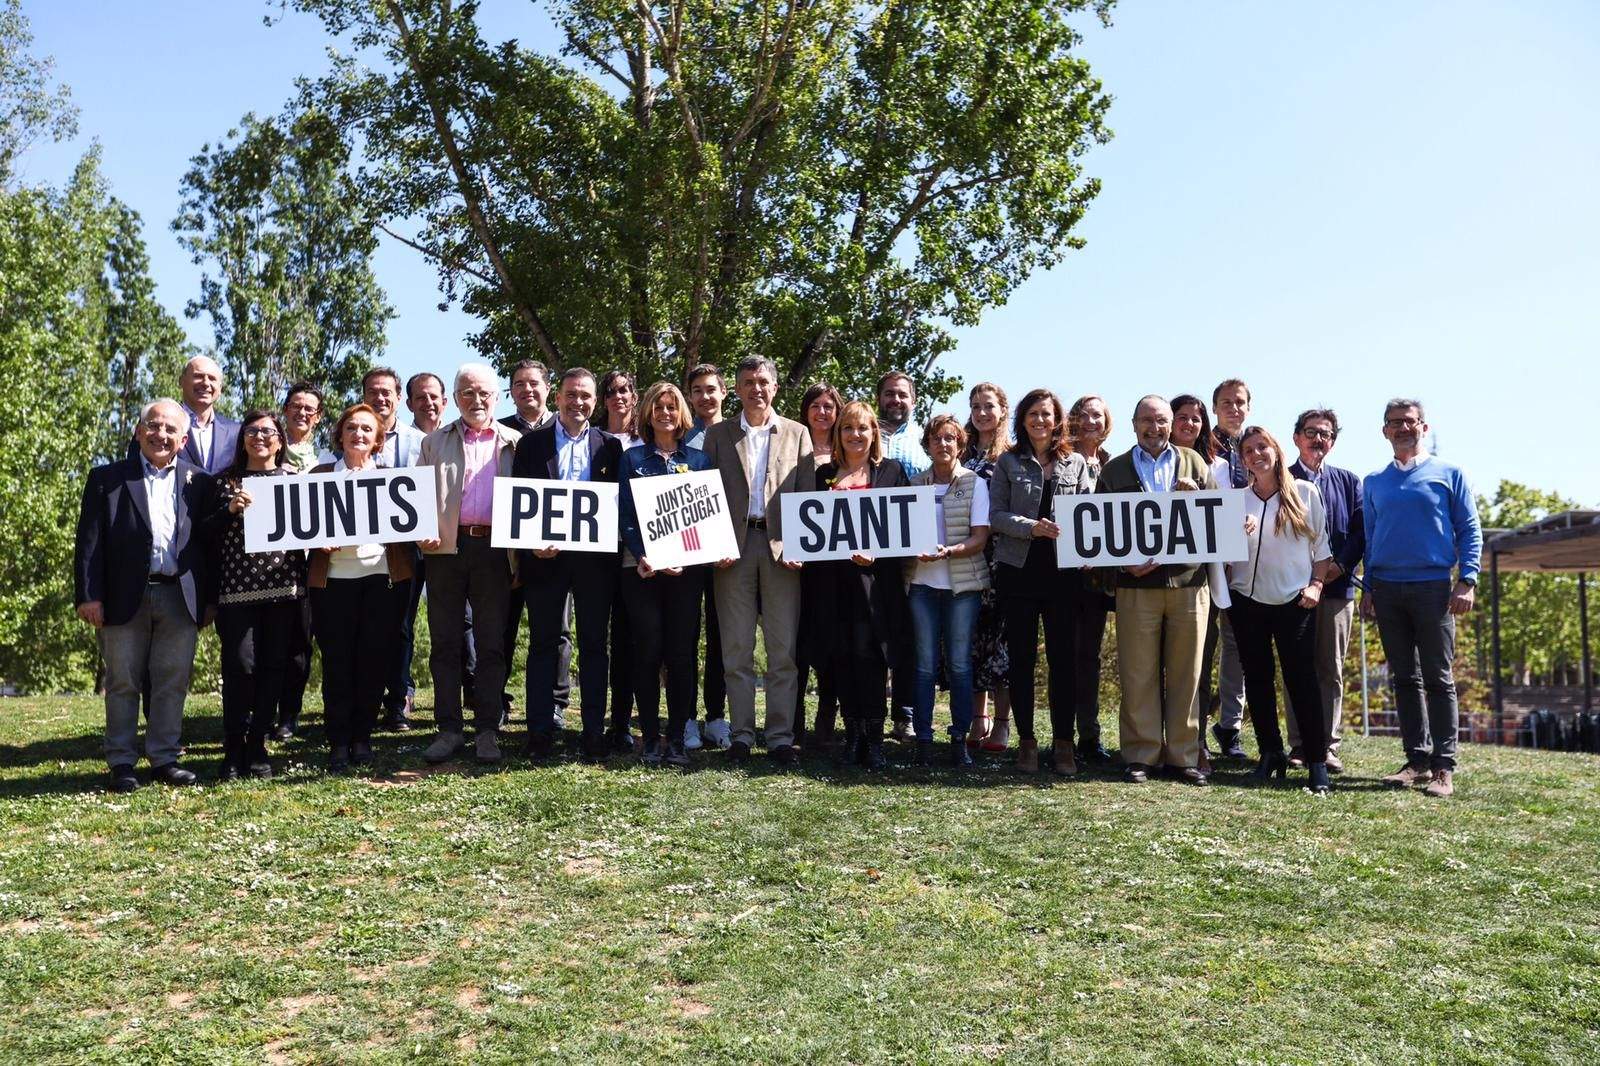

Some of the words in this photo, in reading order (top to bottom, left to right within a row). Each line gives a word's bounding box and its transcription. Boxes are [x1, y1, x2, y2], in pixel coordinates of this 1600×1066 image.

[268, 476, 418, 543] JUNTS
[511, 486, 599, 543] PER
[647, 510, 679, 542] SANT
[681, 493, 721, 527] CUGAT
[655, 483, 694, 516] JUNTS
[694, 484, 709, 500] PER
[799, 495, 918, 554] SANT
[1074, 498, 1223, 559] CUGAT
